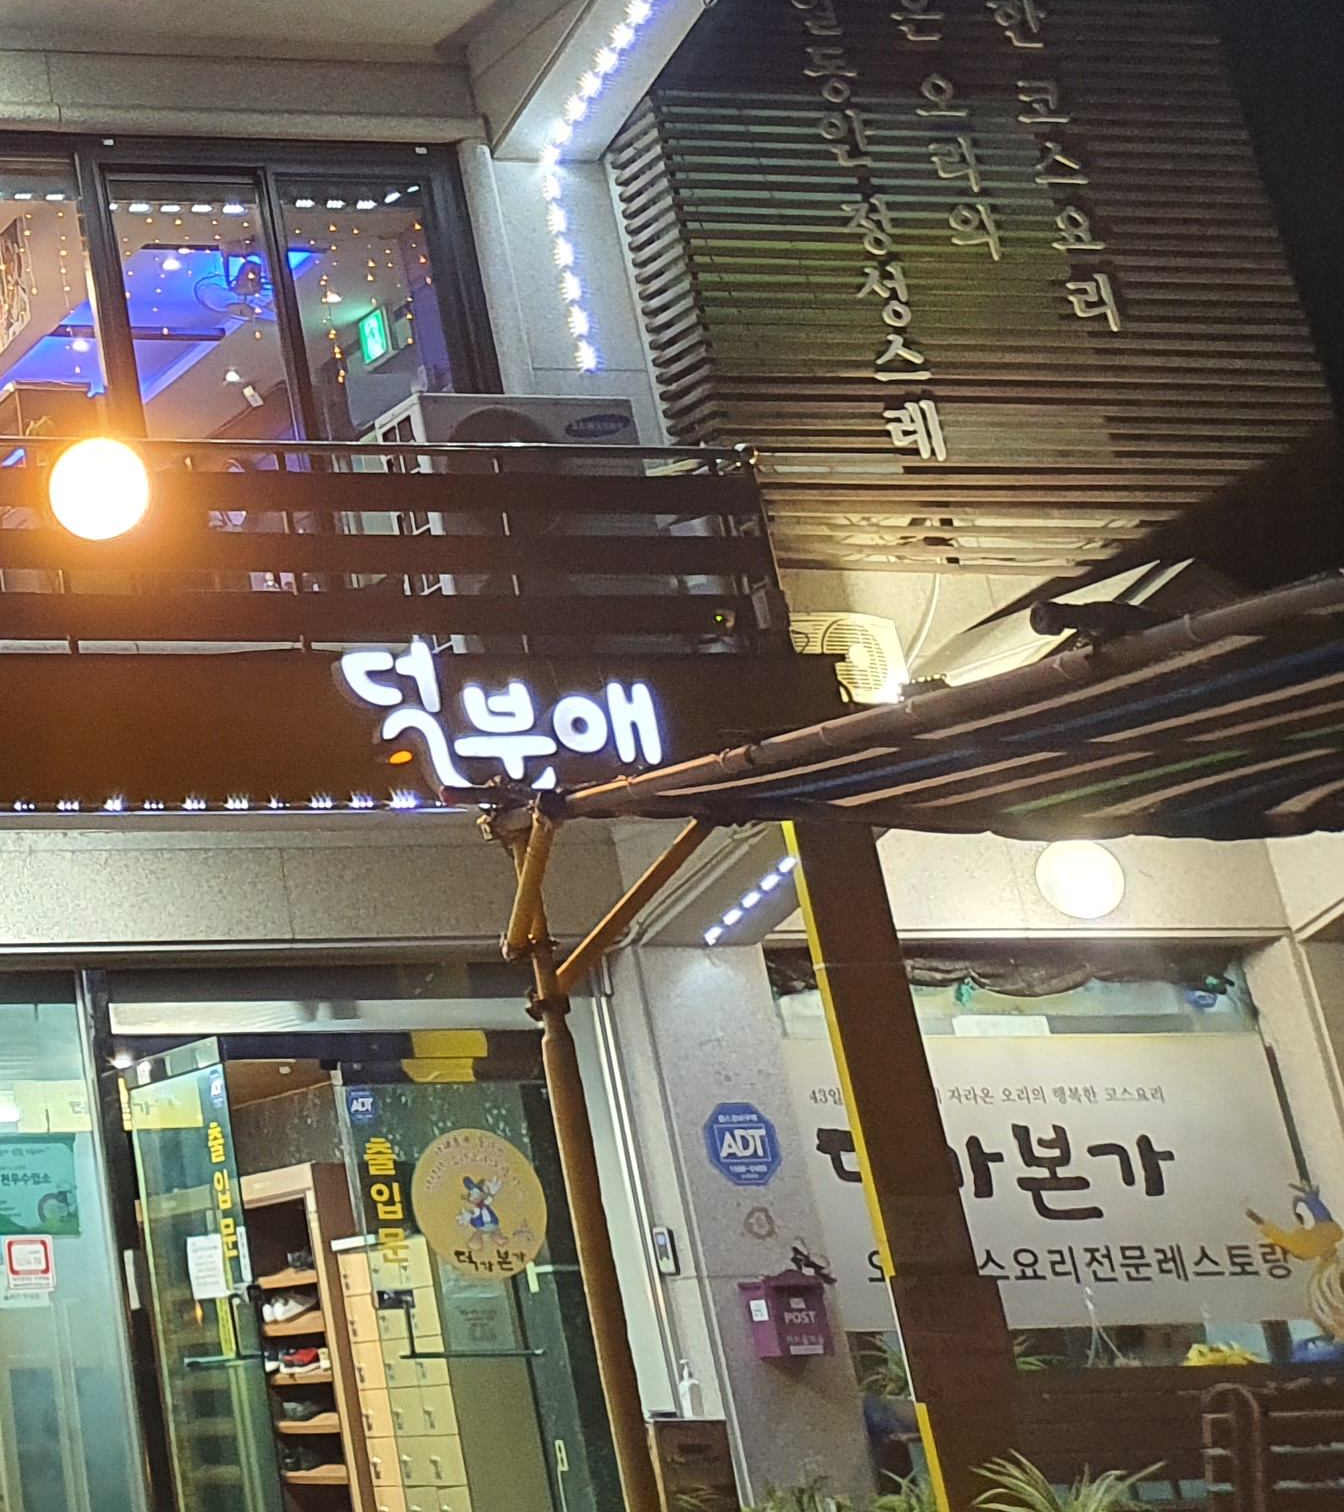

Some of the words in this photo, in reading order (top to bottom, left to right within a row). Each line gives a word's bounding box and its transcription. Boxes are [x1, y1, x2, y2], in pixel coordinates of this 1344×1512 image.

[914, 72, 1002, 262] 오리의
[1017, 79, 1121, 333] 코스요리
[350, 1097, 374, 1113] ADT
[1000, 1085, 1047, 1105] 오리의
[720, 1128, 767, 1159] ADT
[206, 1121, 239, 1259] 출입문
[363, 1137, 410, 1264] 출입문
[783, 1311, 816, 1324] POST
